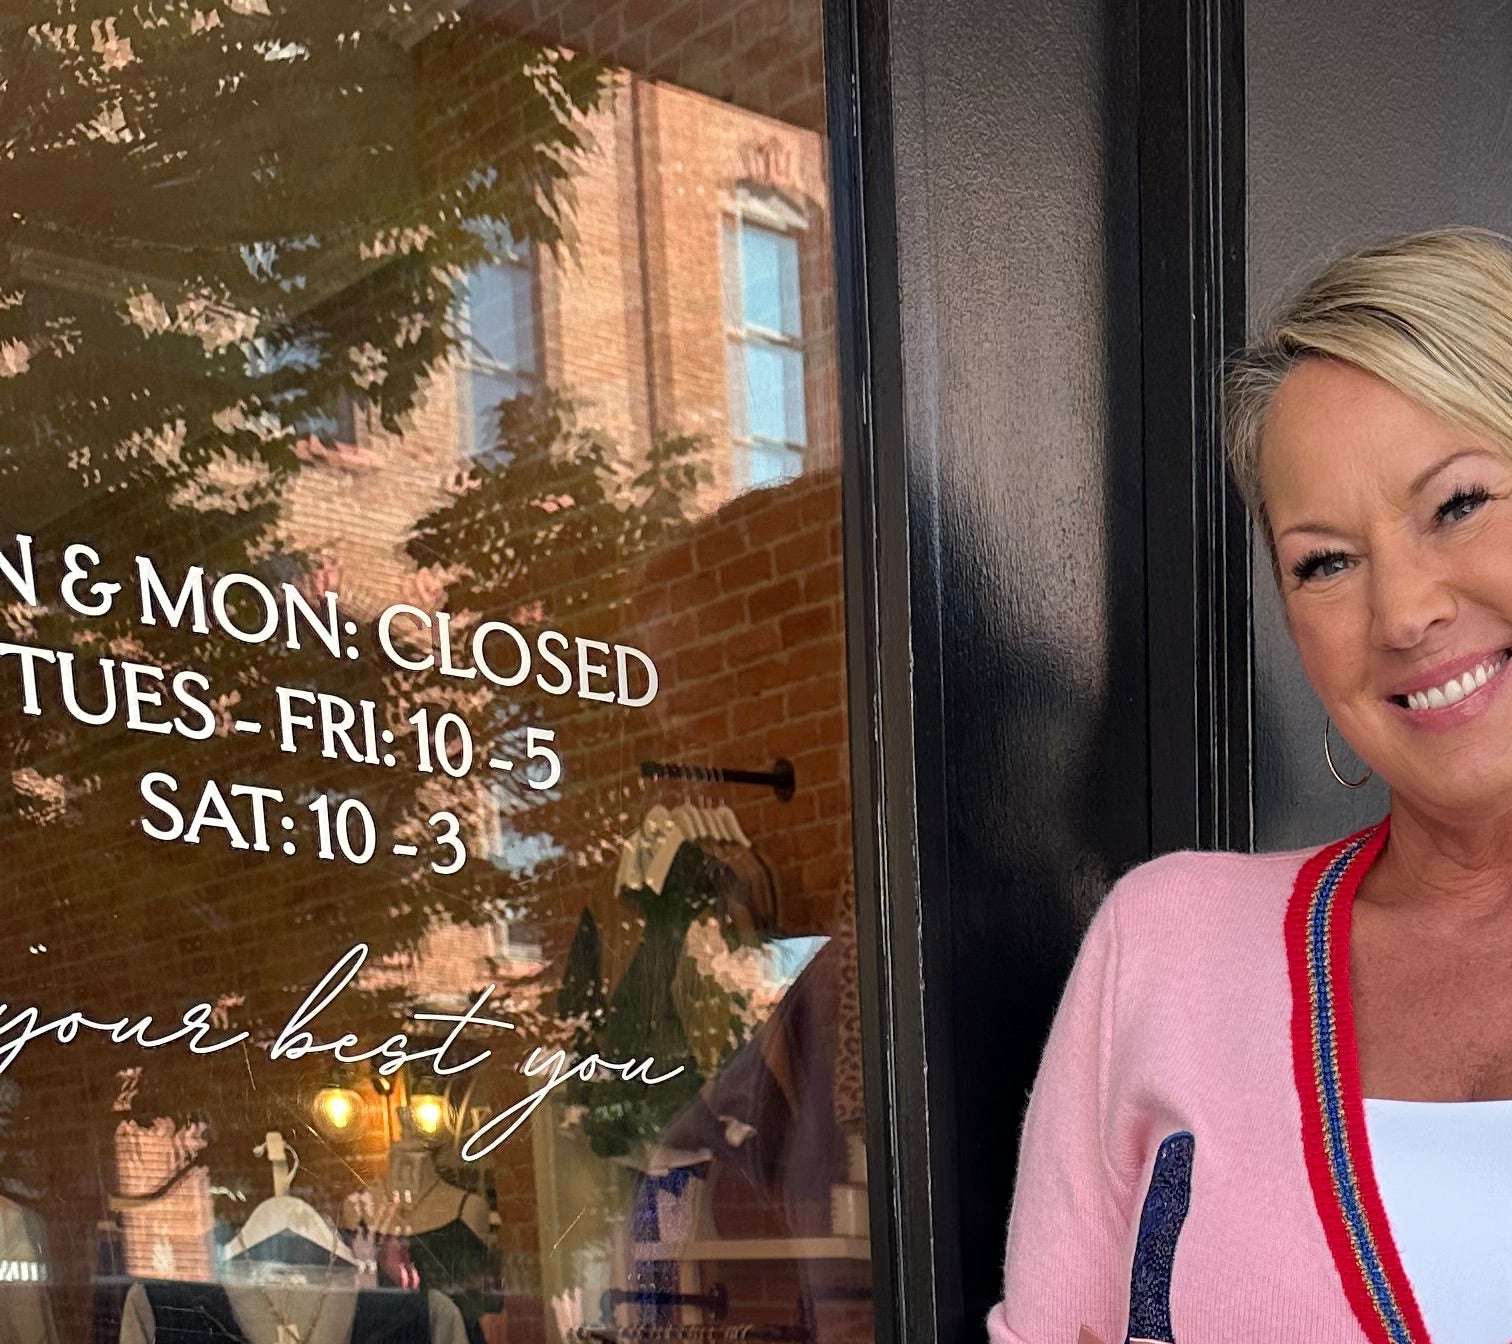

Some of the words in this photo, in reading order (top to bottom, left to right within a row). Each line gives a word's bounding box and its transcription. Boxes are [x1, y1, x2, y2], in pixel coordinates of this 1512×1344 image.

[61, 544, 121, 616] &
[135, 555, 359, 660] MON:
[378, 604, 658, 707] CLOSED
[0, 642, 216, 740] TUES
[275, 686, 396, 766] FRI:
[408, 708, 473, 778] 10
[526, 726, 561, 790] 5
[140, 772, 295, 855] SAT:
[308, 794, 376, 864] 10
[428, 811, 467, 875] 3
[0, 1000, 250, 1074] your
[270, 943, 515, 1076] best
[461, 1046, 685, 1163] you
